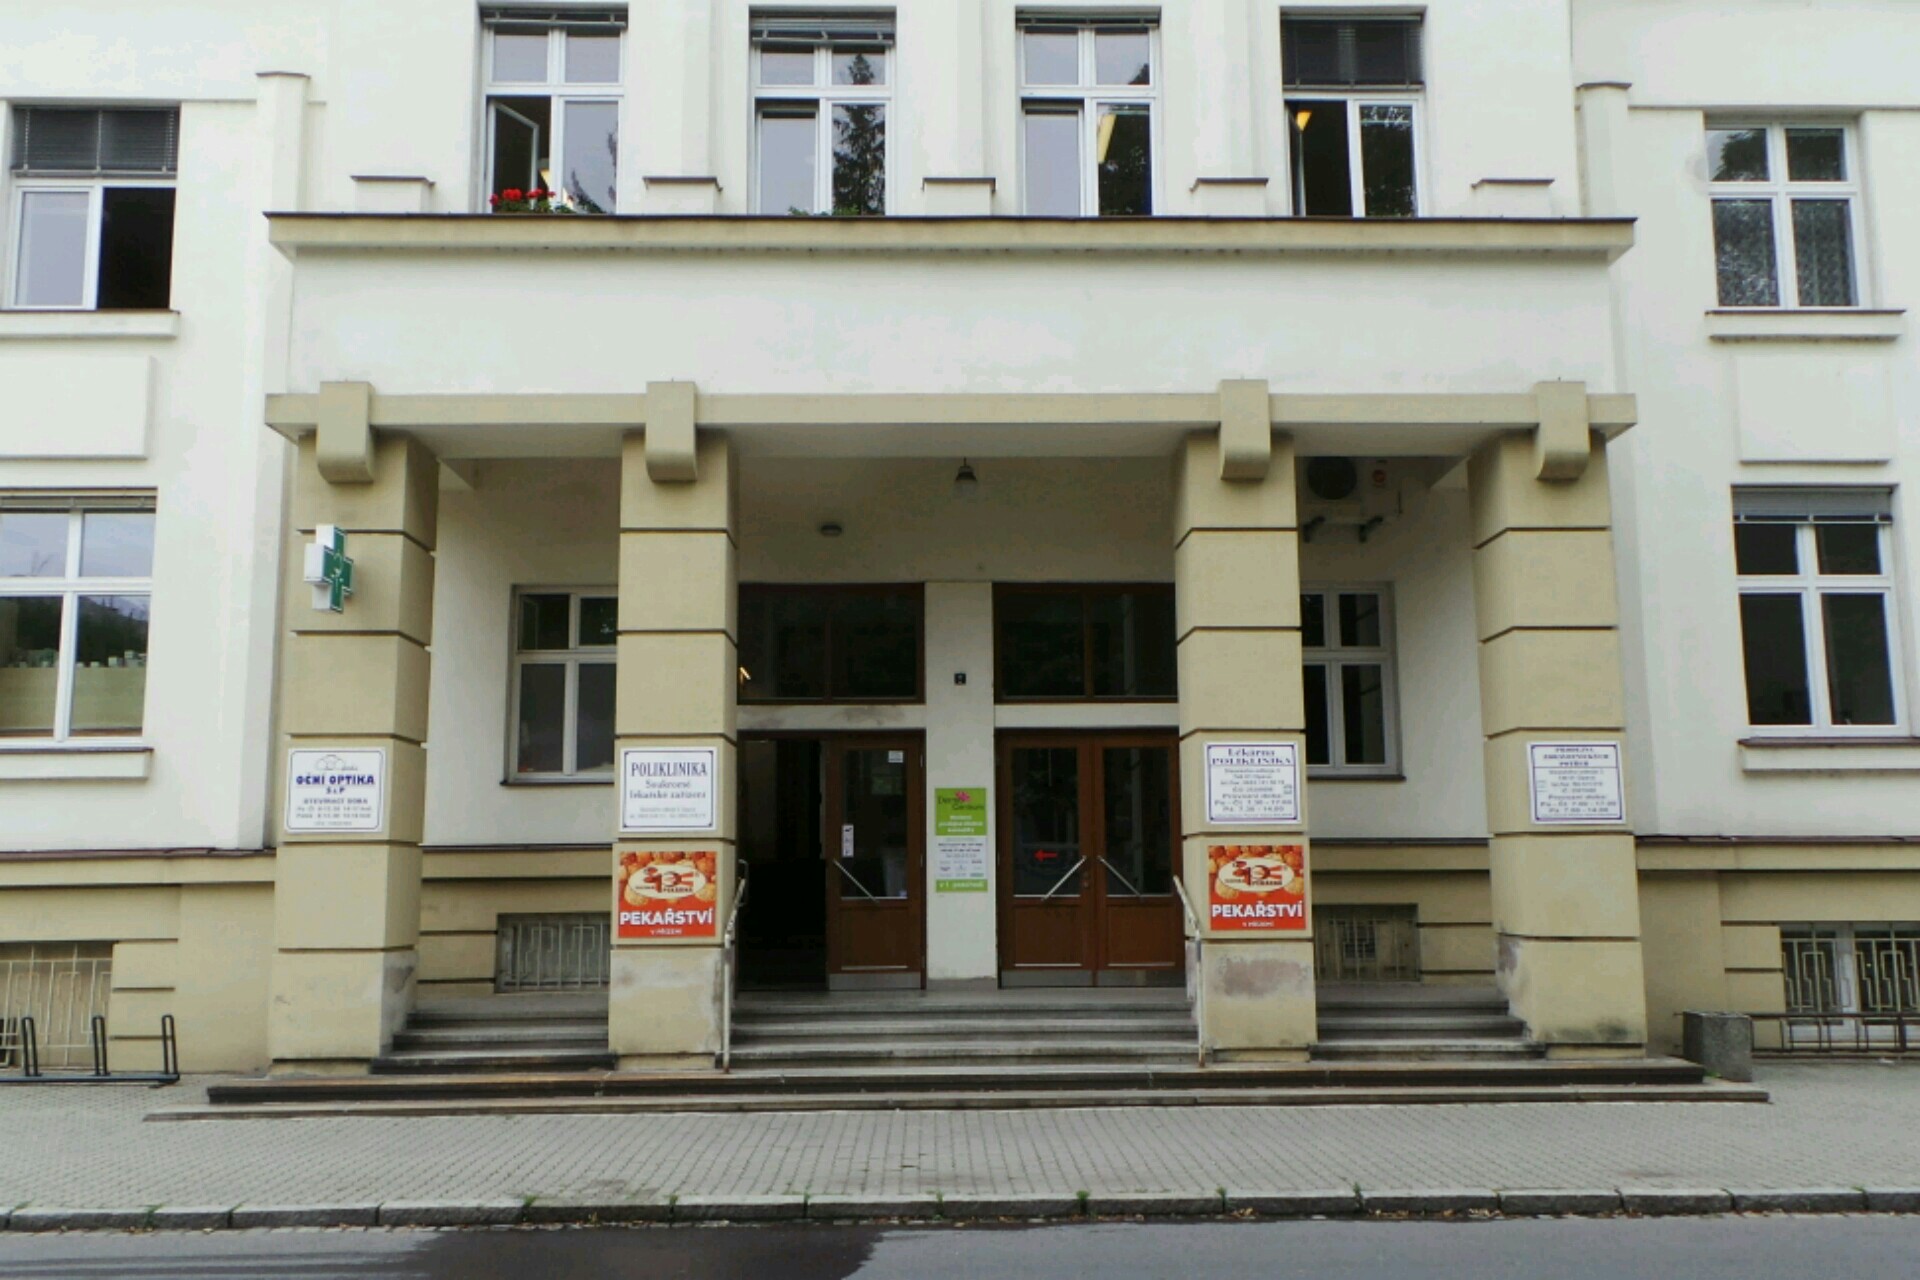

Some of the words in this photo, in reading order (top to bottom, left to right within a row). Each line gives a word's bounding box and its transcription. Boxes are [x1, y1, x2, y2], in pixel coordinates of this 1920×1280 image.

[631, 762, 707, 777] POLIKLINIKA
[329, 775, 375, 785] OPTIKA
[620, 908, 713, 925] PEKAŘSTVÍ
[1212, 900, 1303, 918] PEKAŘSTVÍ
